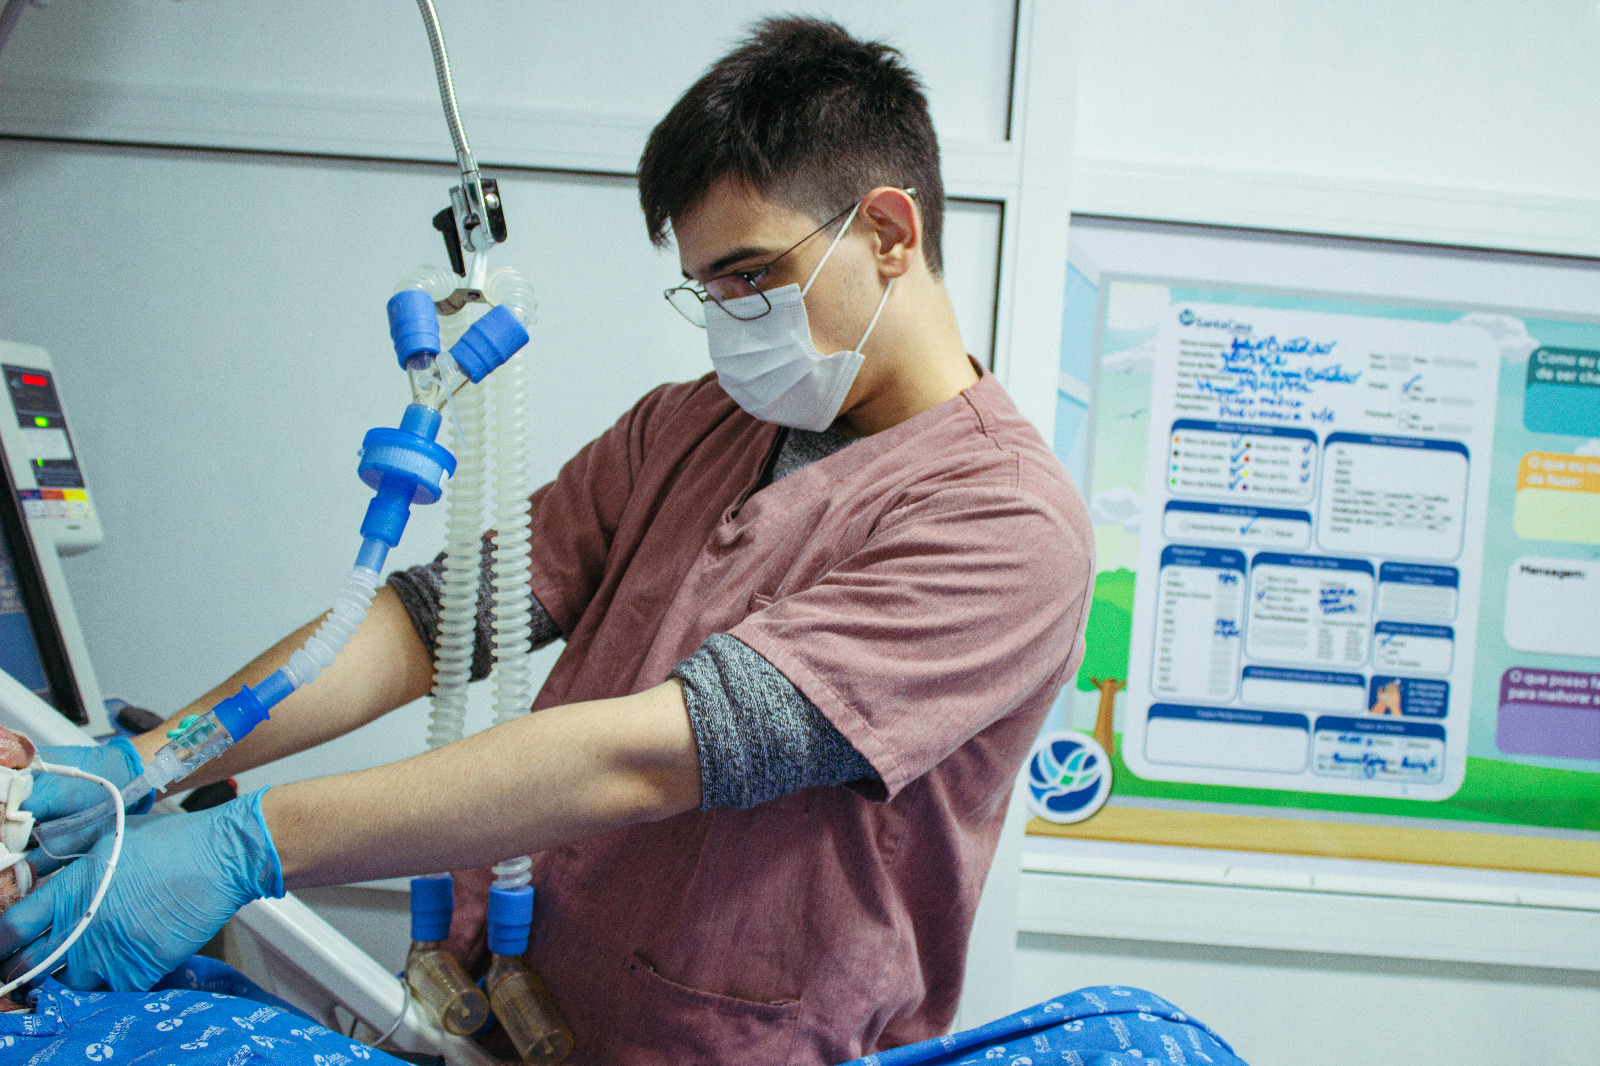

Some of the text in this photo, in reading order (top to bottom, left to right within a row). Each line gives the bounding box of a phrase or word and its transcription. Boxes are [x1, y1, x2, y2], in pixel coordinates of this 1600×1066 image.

[1537, 351, 1595, 368] Como eu
[1535, 368, 1554, 381] de
[1556, 370, 1577, 382] ser
[1528, 456, 1540, 469] O
[1541, 460, 1566, 472] que
[1568, 461, 1584, 473] eu
[1526, 473, 1544, 485] de
[1520, 564, 1586, 579] Mensagem:
[1509, 669, 1523, 684] O
[1523, 673, 1548, 687] que
[1549, 675, 1588, 689] posso
[1507, 687, 1537, 701] para
[1537, 689, 1590, 704] melhorar
